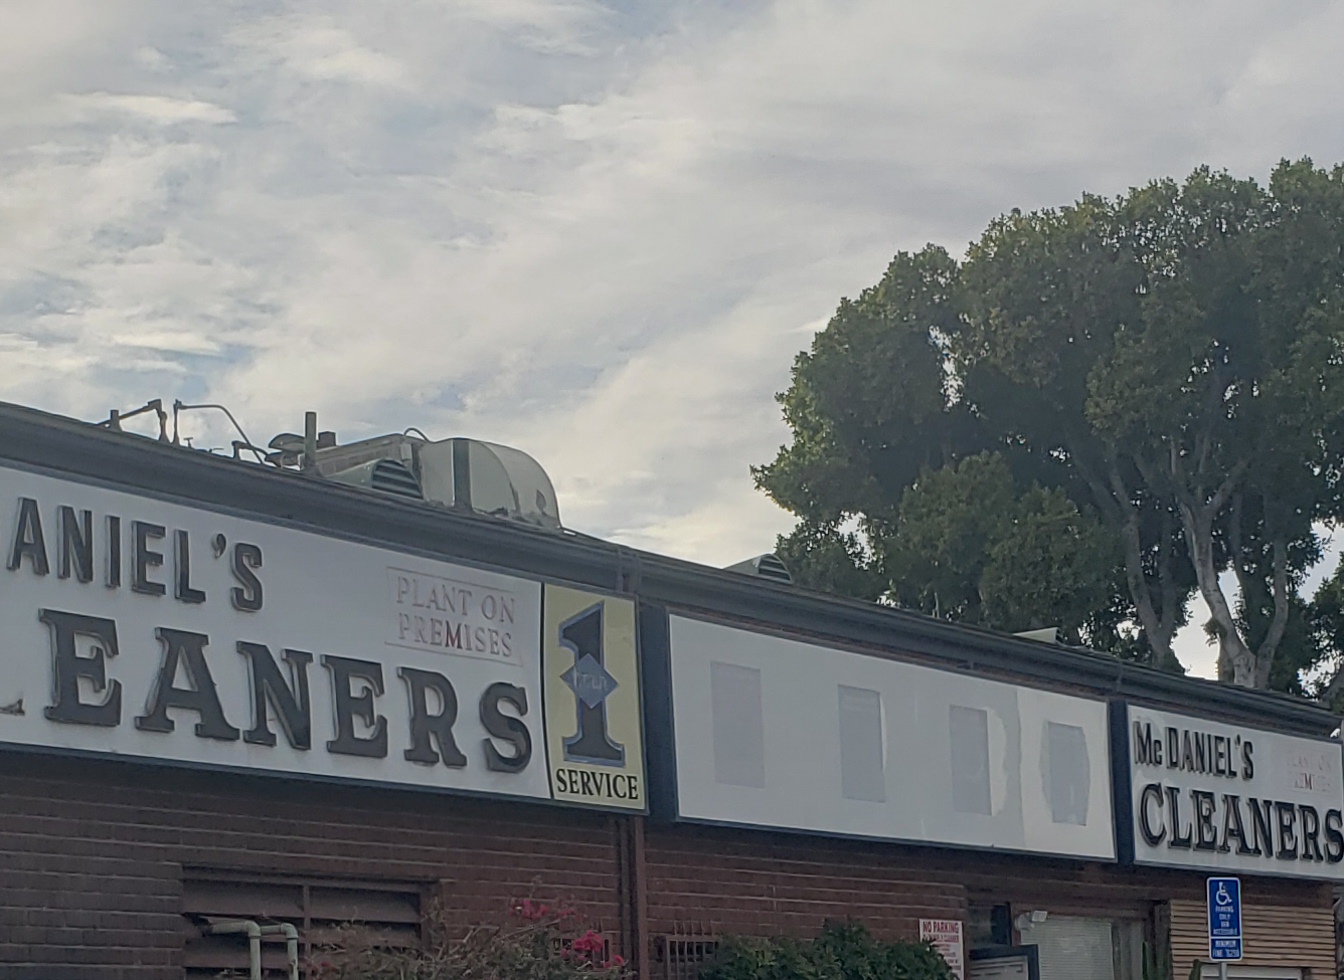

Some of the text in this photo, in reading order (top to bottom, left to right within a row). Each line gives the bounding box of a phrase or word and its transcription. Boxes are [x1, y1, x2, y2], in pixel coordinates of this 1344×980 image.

[396, 575, 516, 625] PLANT ON
[398, 611, 513, 659] PREMISES
[559, 599, 627, 769] 1
[556, 767, 640, 801] SERVICE
[922, 921, 959, 934] NO PARKING
